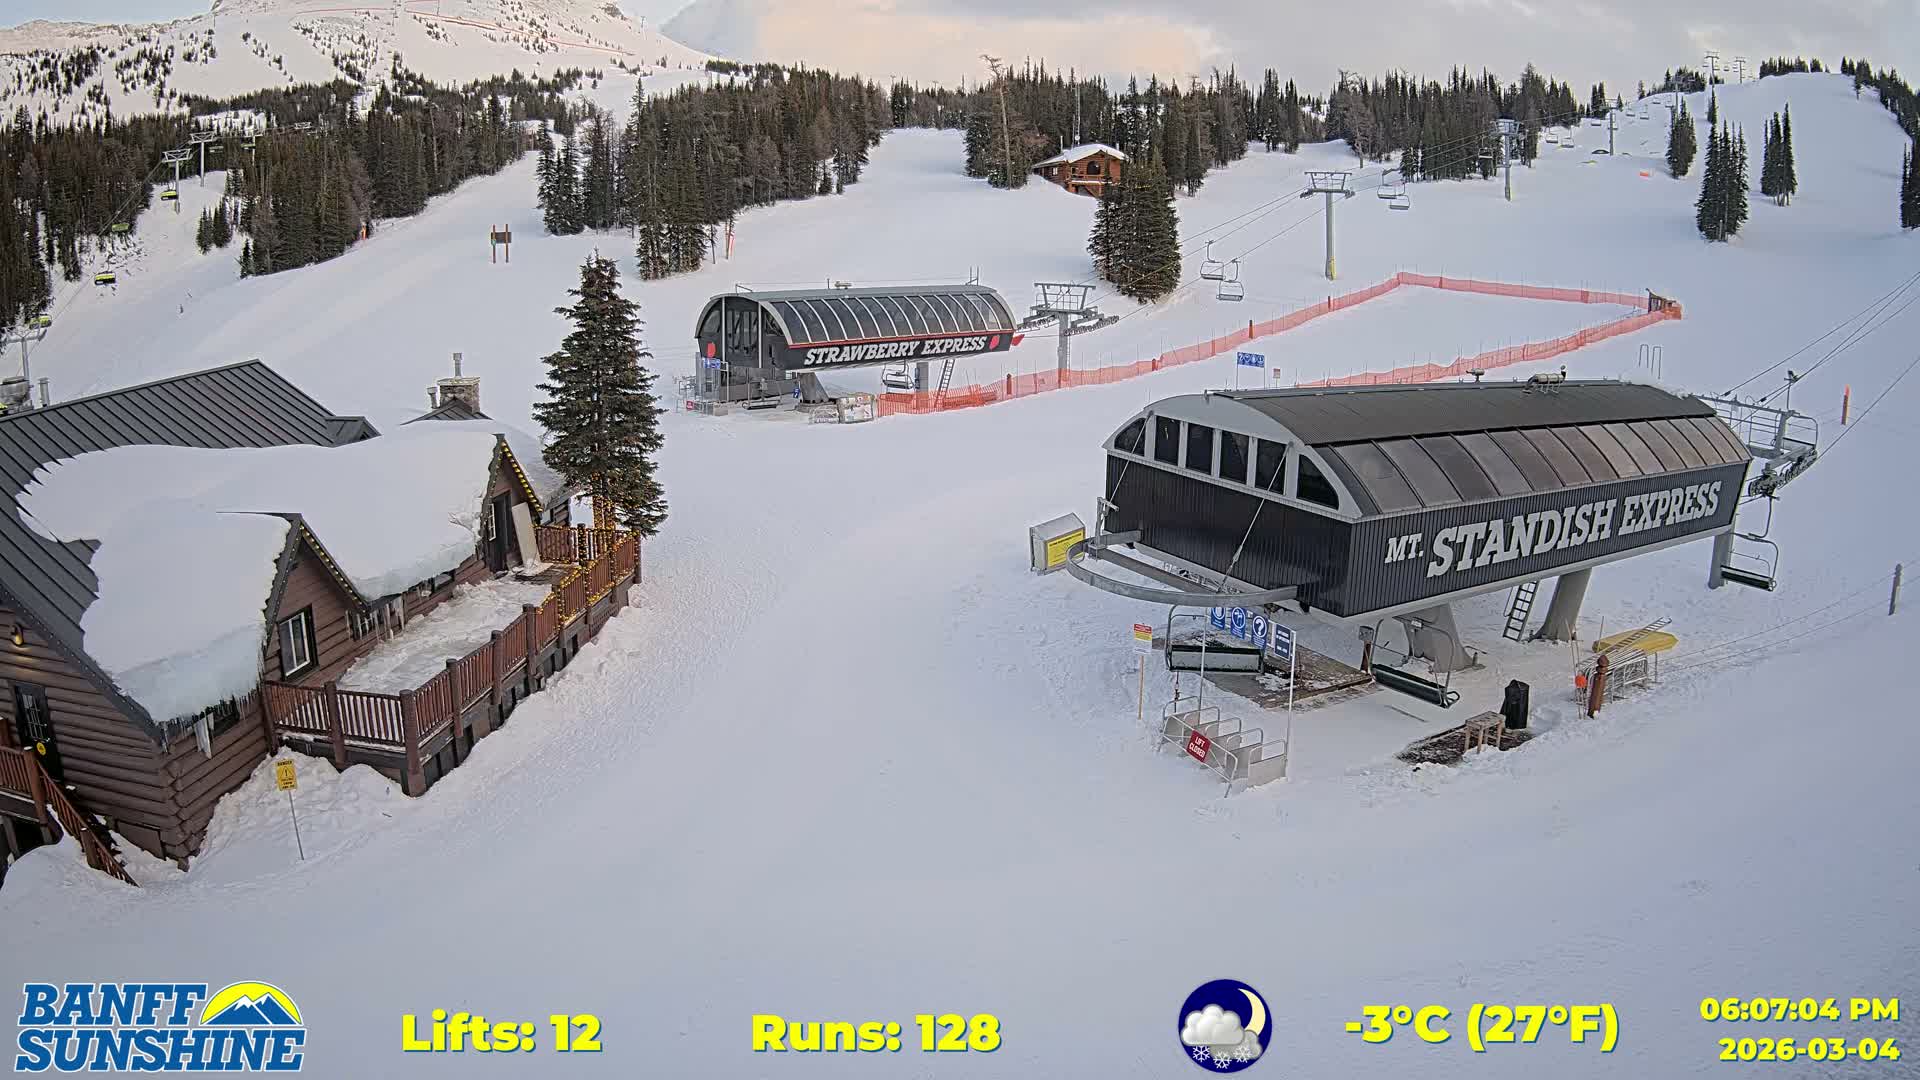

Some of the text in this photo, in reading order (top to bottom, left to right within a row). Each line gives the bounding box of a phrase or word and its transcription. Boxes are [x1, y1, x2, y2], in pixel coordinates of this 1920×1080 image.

[804, 335, 987, 366] STRAWBERRY EXPRESS
[1384, 480, 1721, 578] MT. STANDISH EXPRESS
[1188, 742, 1206, 758] CLOSED
[1194, 735, 1206, 748] LIFT
